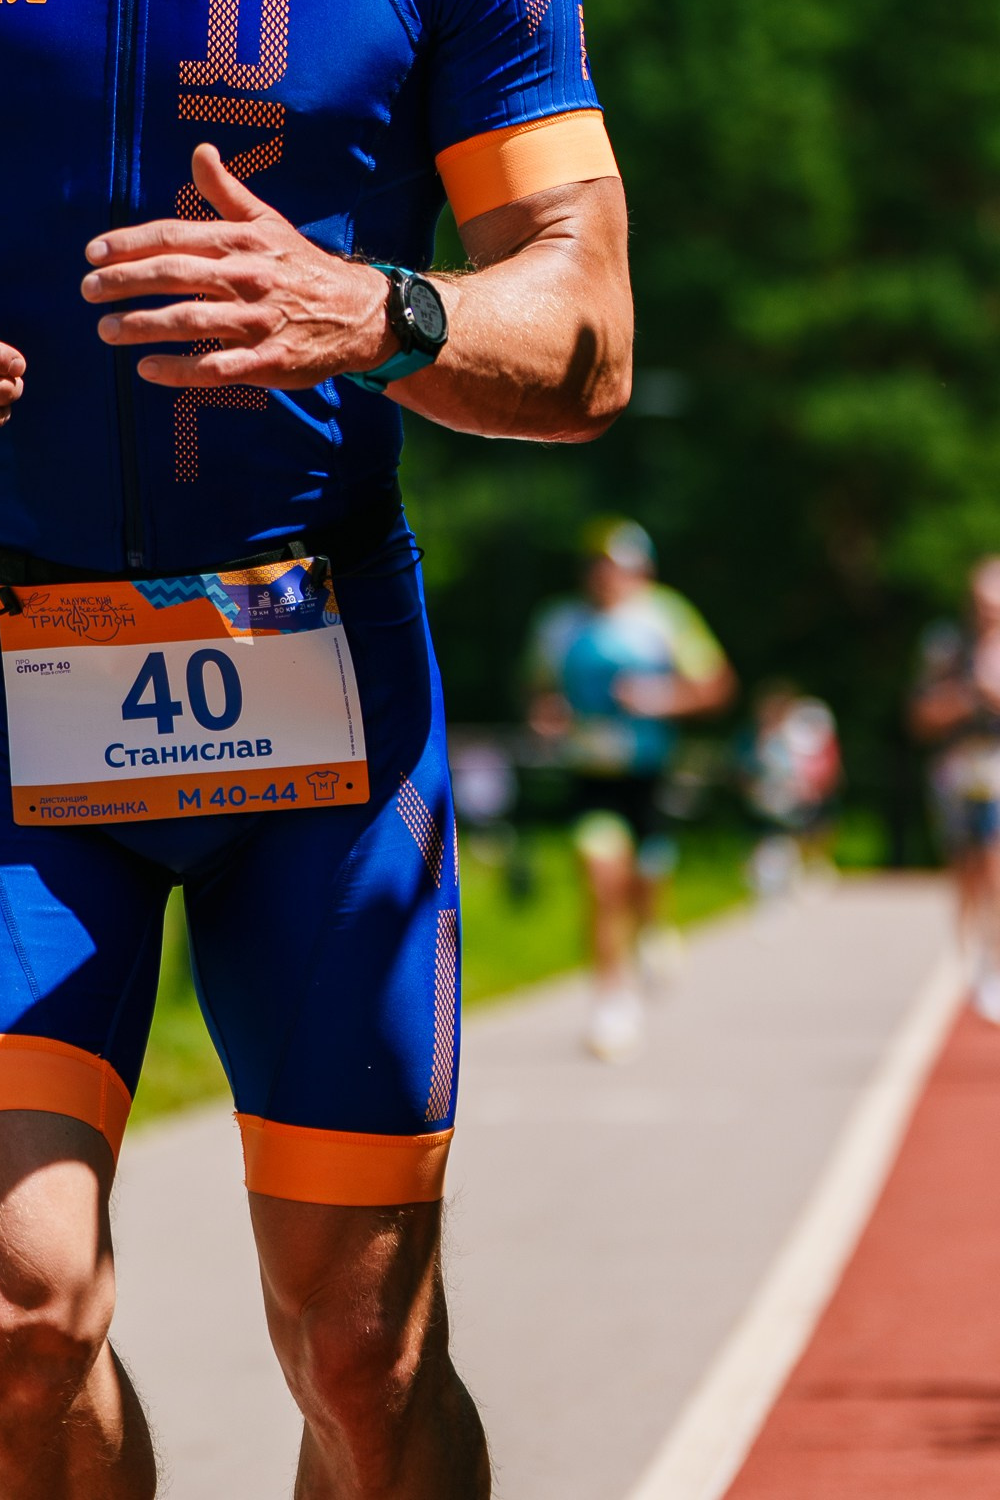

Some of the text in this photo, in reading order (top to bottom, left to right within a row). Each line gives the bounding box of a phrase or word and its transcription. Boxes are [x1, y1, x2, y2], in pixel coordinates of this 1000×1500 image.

[16, 661, 71, 674] СПОРТ 40
[121, 648, 243, 735] 40
[104, 738, 273, 769] Станислав
[39, 795, 88, 805] ДИСТАНЦИЯ
[178, 782, 298, 810] М 40-44
[40, 800, 148, 819] ПОЛОВИНКА
